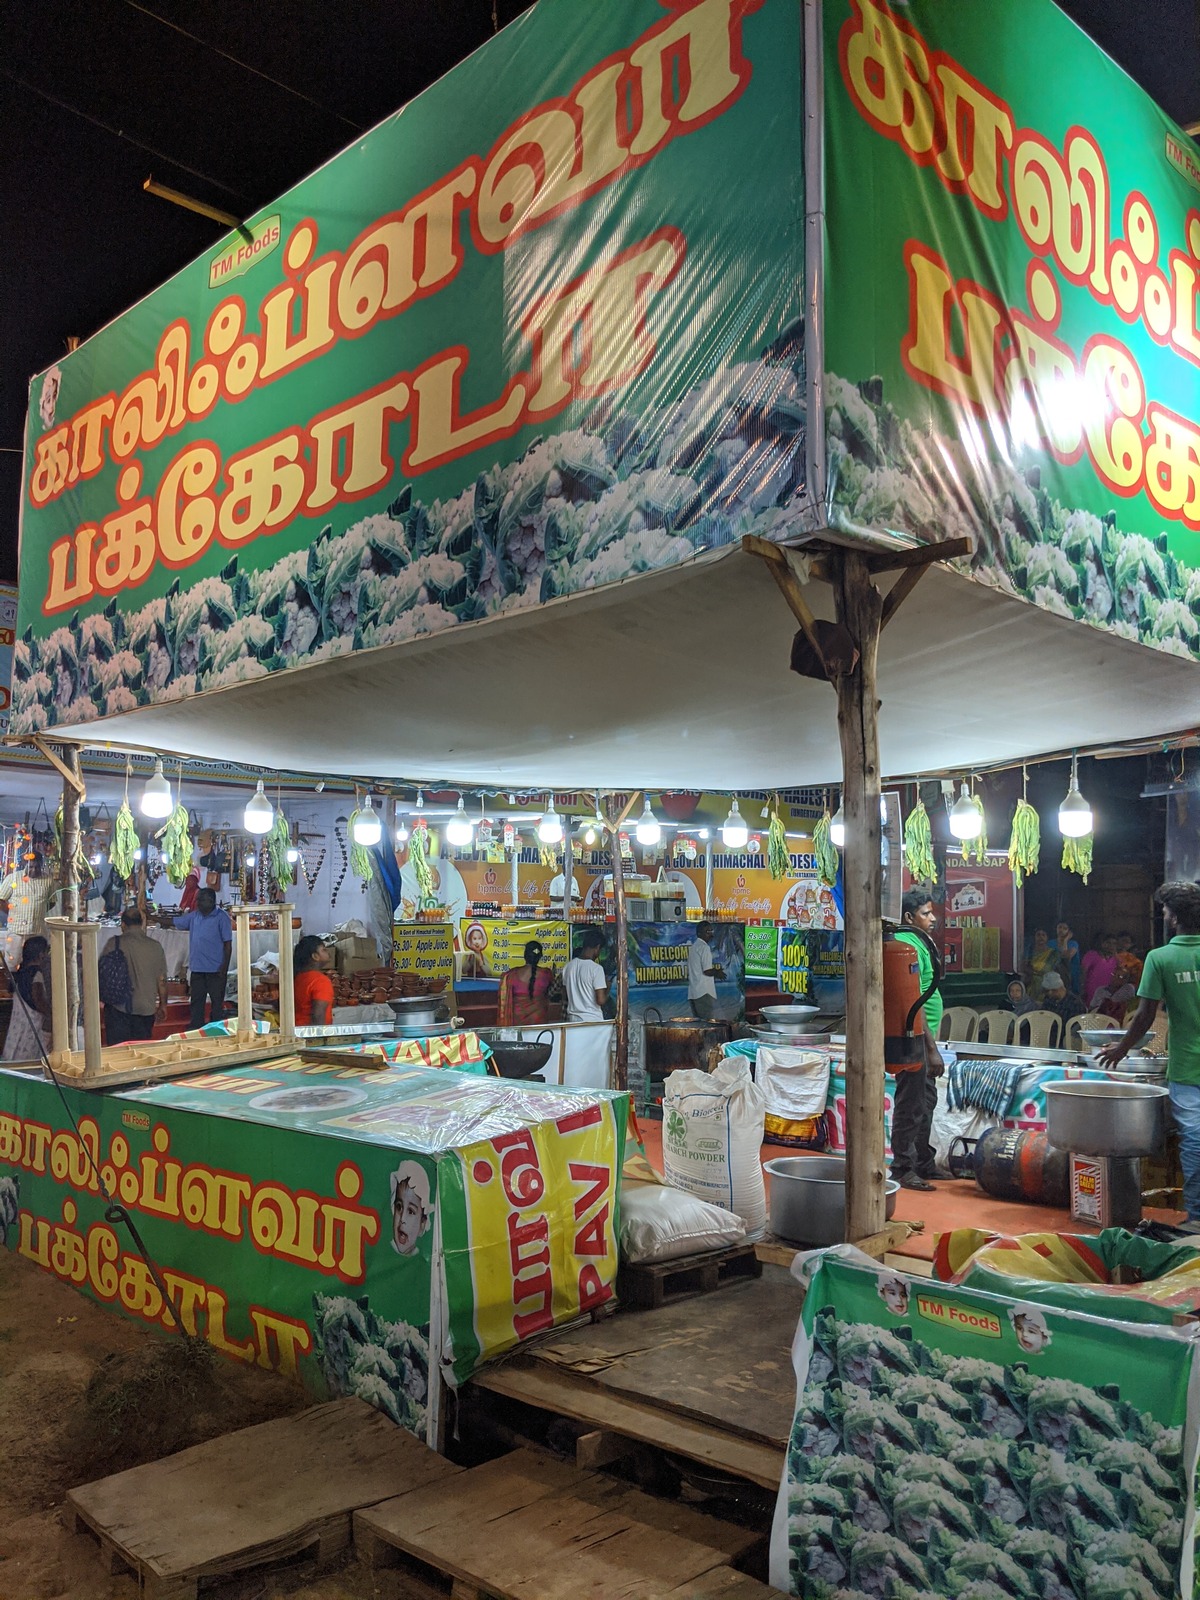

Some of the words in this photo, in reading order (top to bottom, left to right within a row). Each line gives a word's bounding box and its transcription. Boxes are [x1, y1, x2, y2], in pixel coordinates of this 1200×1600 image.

[1167, 138, 1182, 165] TM
[211, 258, 234, 279] TM
[236, 224, 280, 263] Foods
[713, 853, 766, 869] HIMACHAL
[945, 858, 973, 868] NDAL
[976, 857, 1006, 868] SOAP
[478, 882, 502, 896] hpmc
[535, 928, 553, 939] Apple
[553, 928, 566, 937] Juice
[416, 939, 432, 952] Apple
[432, 938, 449, 950] Juice
[551, 941, 567, 950] Juice
[552, 954, 567, 962] Juice
[782, 944, 809, 968] 100%
[415, 957, 436, 971] Orange
[436, 957, 452, 968] Juice
[636, 964, 682, 982] HIMACHAL
[781, 970, 808, 993] PURE
[123, 1112, 132, 1123] TM
[133, 1113, 150, 1127] Foods
[688, 1150, 726, 1163] POWDER
[568, 1162, 612, 1312] PAV
[919, 1298, 944, 1317] TM
[949, 1306, 1000, 1333] Foods
